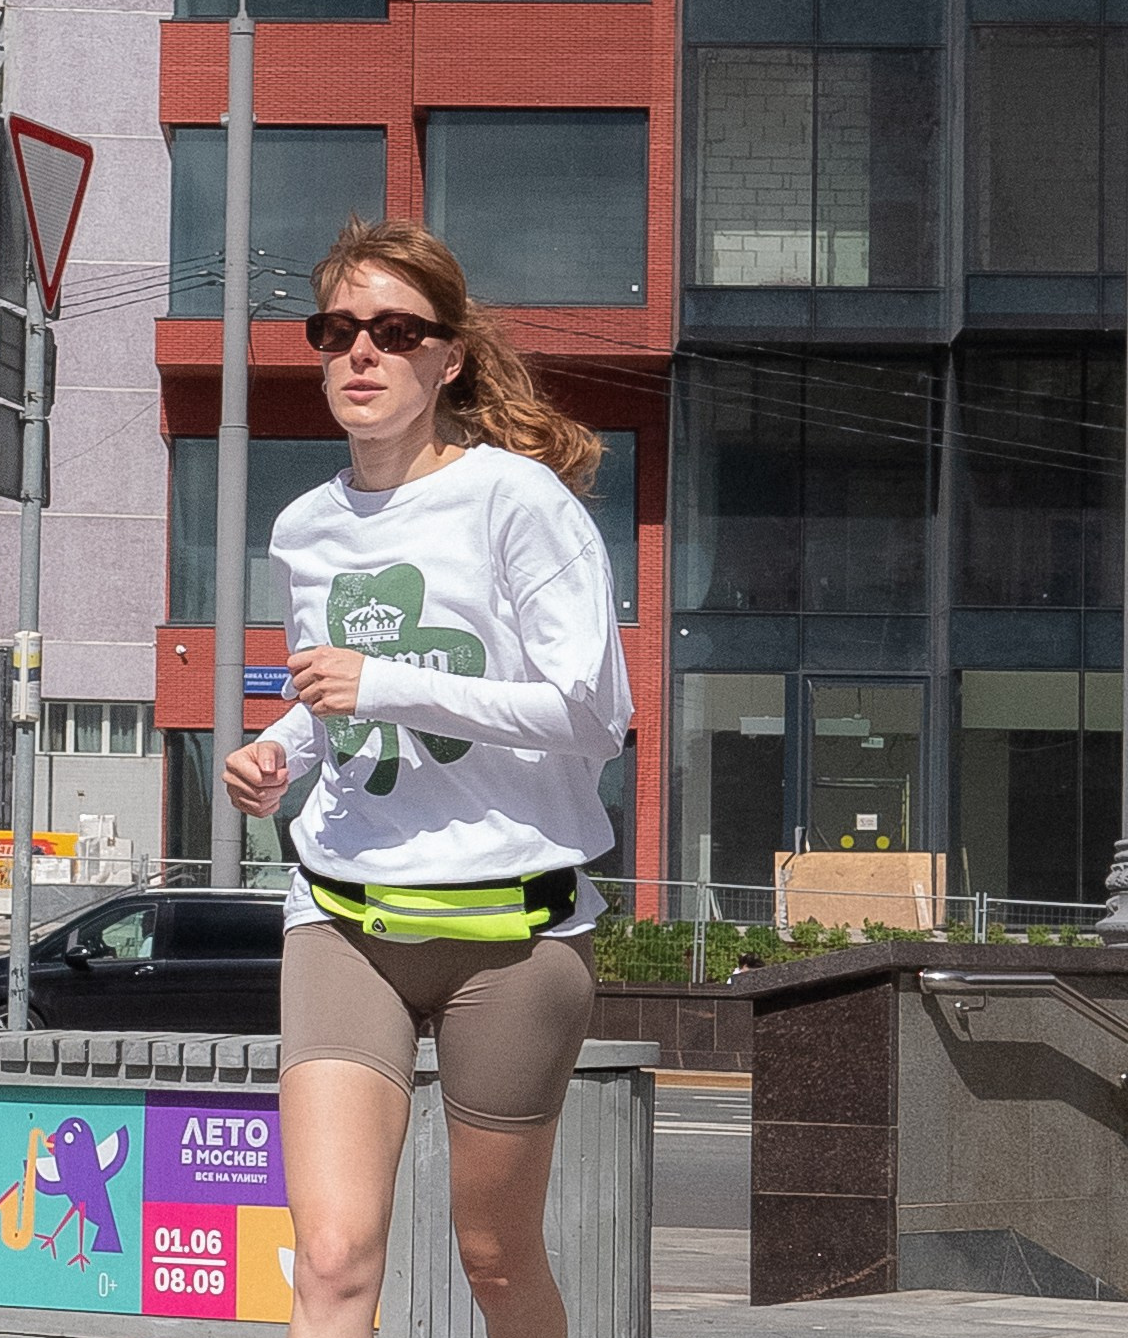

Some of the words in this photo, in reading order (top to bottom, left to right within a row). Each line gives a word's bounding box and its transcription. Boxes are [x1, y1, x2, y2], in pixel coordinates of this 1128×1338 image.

[181, 1117, 269, 1148] ЛЕТО
[181, 1148, 193, 1164] В
[195, 1149, 268, 1167] МОСКВЕ
[195, 1171, 214, 1182] ВСЕ
[215, 1172, 230, 1182] НА
[230, 1173, 268, 1184] УЛИЦУ!
[154, 1227, 222, 1255] 01.06
[98, 1272, 118, 1297] 0+
[154, 1267, 225, 1295] 08.09
